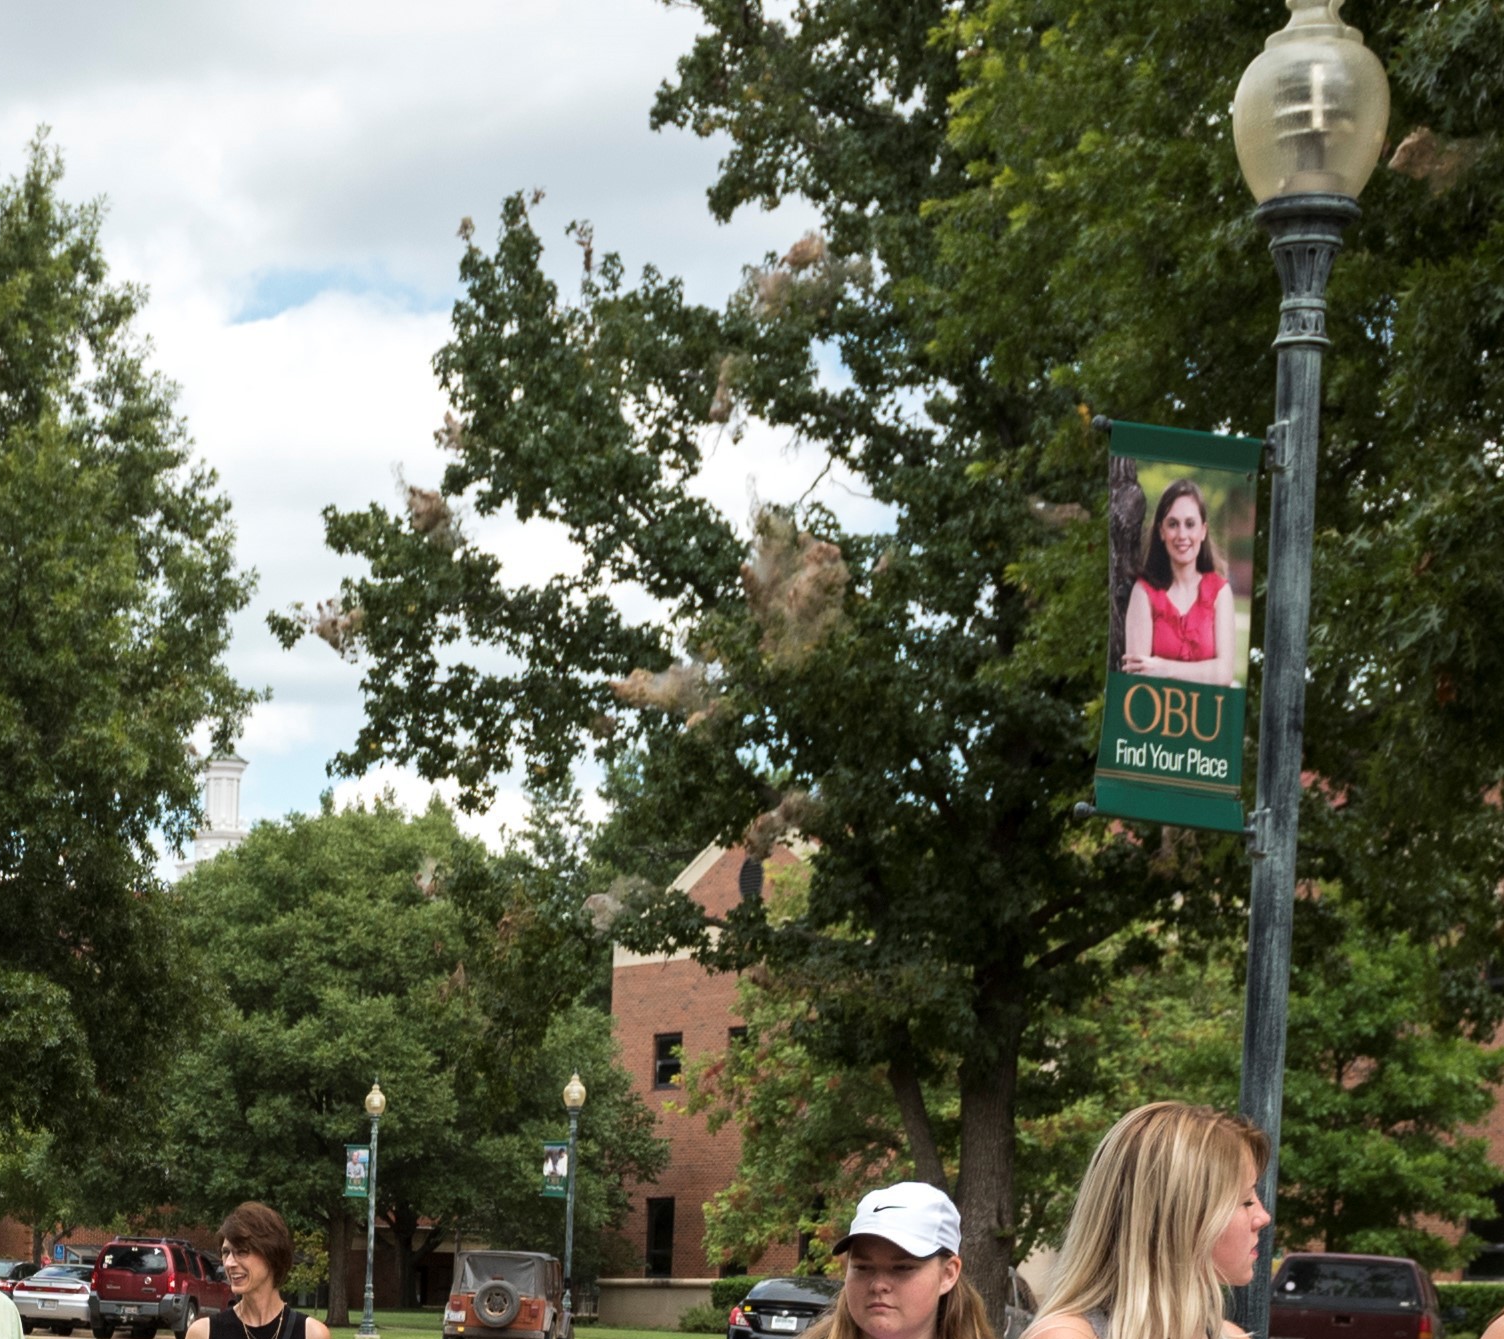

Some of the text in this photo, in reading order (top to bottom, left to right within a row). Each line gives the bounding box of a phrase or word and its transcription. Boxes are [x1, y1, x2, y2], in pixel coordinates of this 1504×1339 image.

[1124, 684, 1224, 742] OBU
[1116, 738, 1228, 779] Find Your Place
